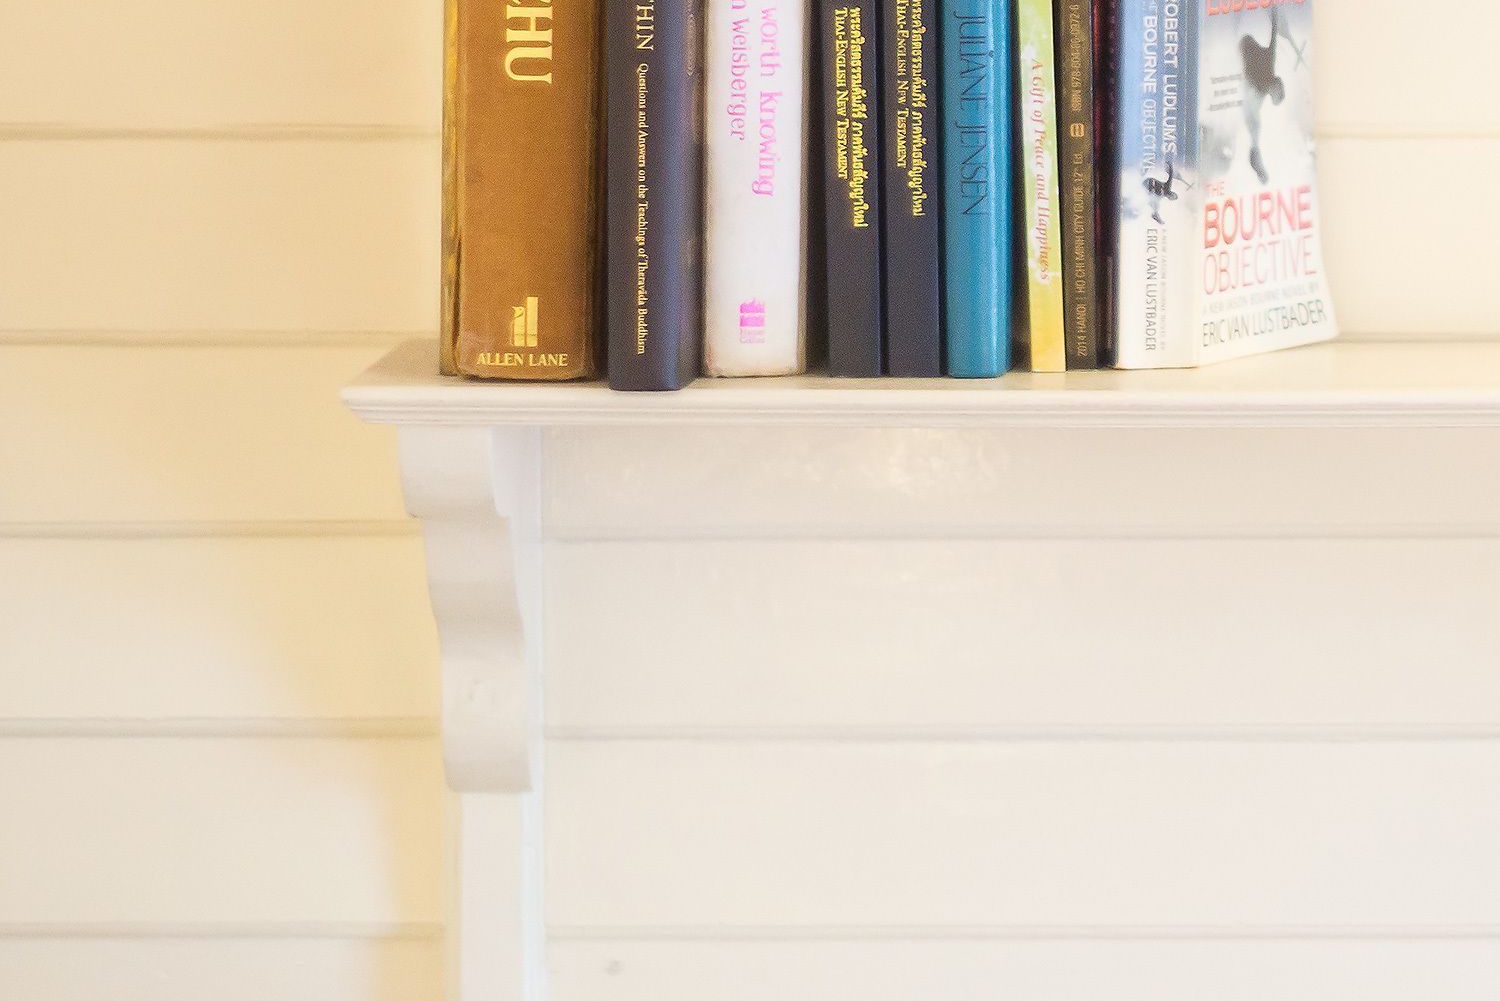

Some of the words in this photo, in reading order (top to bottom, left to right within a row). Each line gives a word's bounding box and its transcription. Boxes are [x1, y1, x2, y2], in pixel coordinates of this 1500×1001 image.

[759, 7, 784, 79] worth
[1143, 15, 1158, 94] BOURNE
[953, 11, 993, 111] JULIANE
[1031, 59, 1043, 71] A
[637, 63, 649, 109] Questions
[1030, 75, 1046, 104] Gift
[1070, 89, 1082, 113] ISBN
[638, 111, 649, 128] and
[1031, 110, 1045, 124] of
[638, 130, 649, 167] Answers
[752, 90, 784, 198] knowing
[1033, 128, 1046, 169] Peace
[1142, 98, 1157, 176] OBJECTIVE
[638, 170, 646, 182] on
[955, 121, 988, 217] JENSEN
[638, 184, 649, 199] the
[1036, 174, 1049, 205] and
[1205, 181, 1225, 197] THE
[635, 202, 649, 246] Teachings
[1073, 214, 1084, 233] CITY
[1204, 184, 1313, 249] BOURNE
[638, 248, 649, 260] of
[1034, 207, 1050, 281] Happiness
[1146, 228, 1158, 254] ERIC
[1146, 256, 1158, 280] VAN
[1204, 235, 1317, 295] OBJECTIVE
[1075, 279, 1086, 293] HO
[637, 308, 649, 355] Buddhism
[1145, 283, 1158, 351] LUSTBADER
[1202, 318, 1226, 347] ERIC
[1226, 313, 1250, 341] VAN
[1252, 299, 1328, 336] LUSTBADER
[476, 353, 524, 367] ALLEN
[528, 353, 568, 367] LANE
[1077, 337, 1088, 357] 2014
